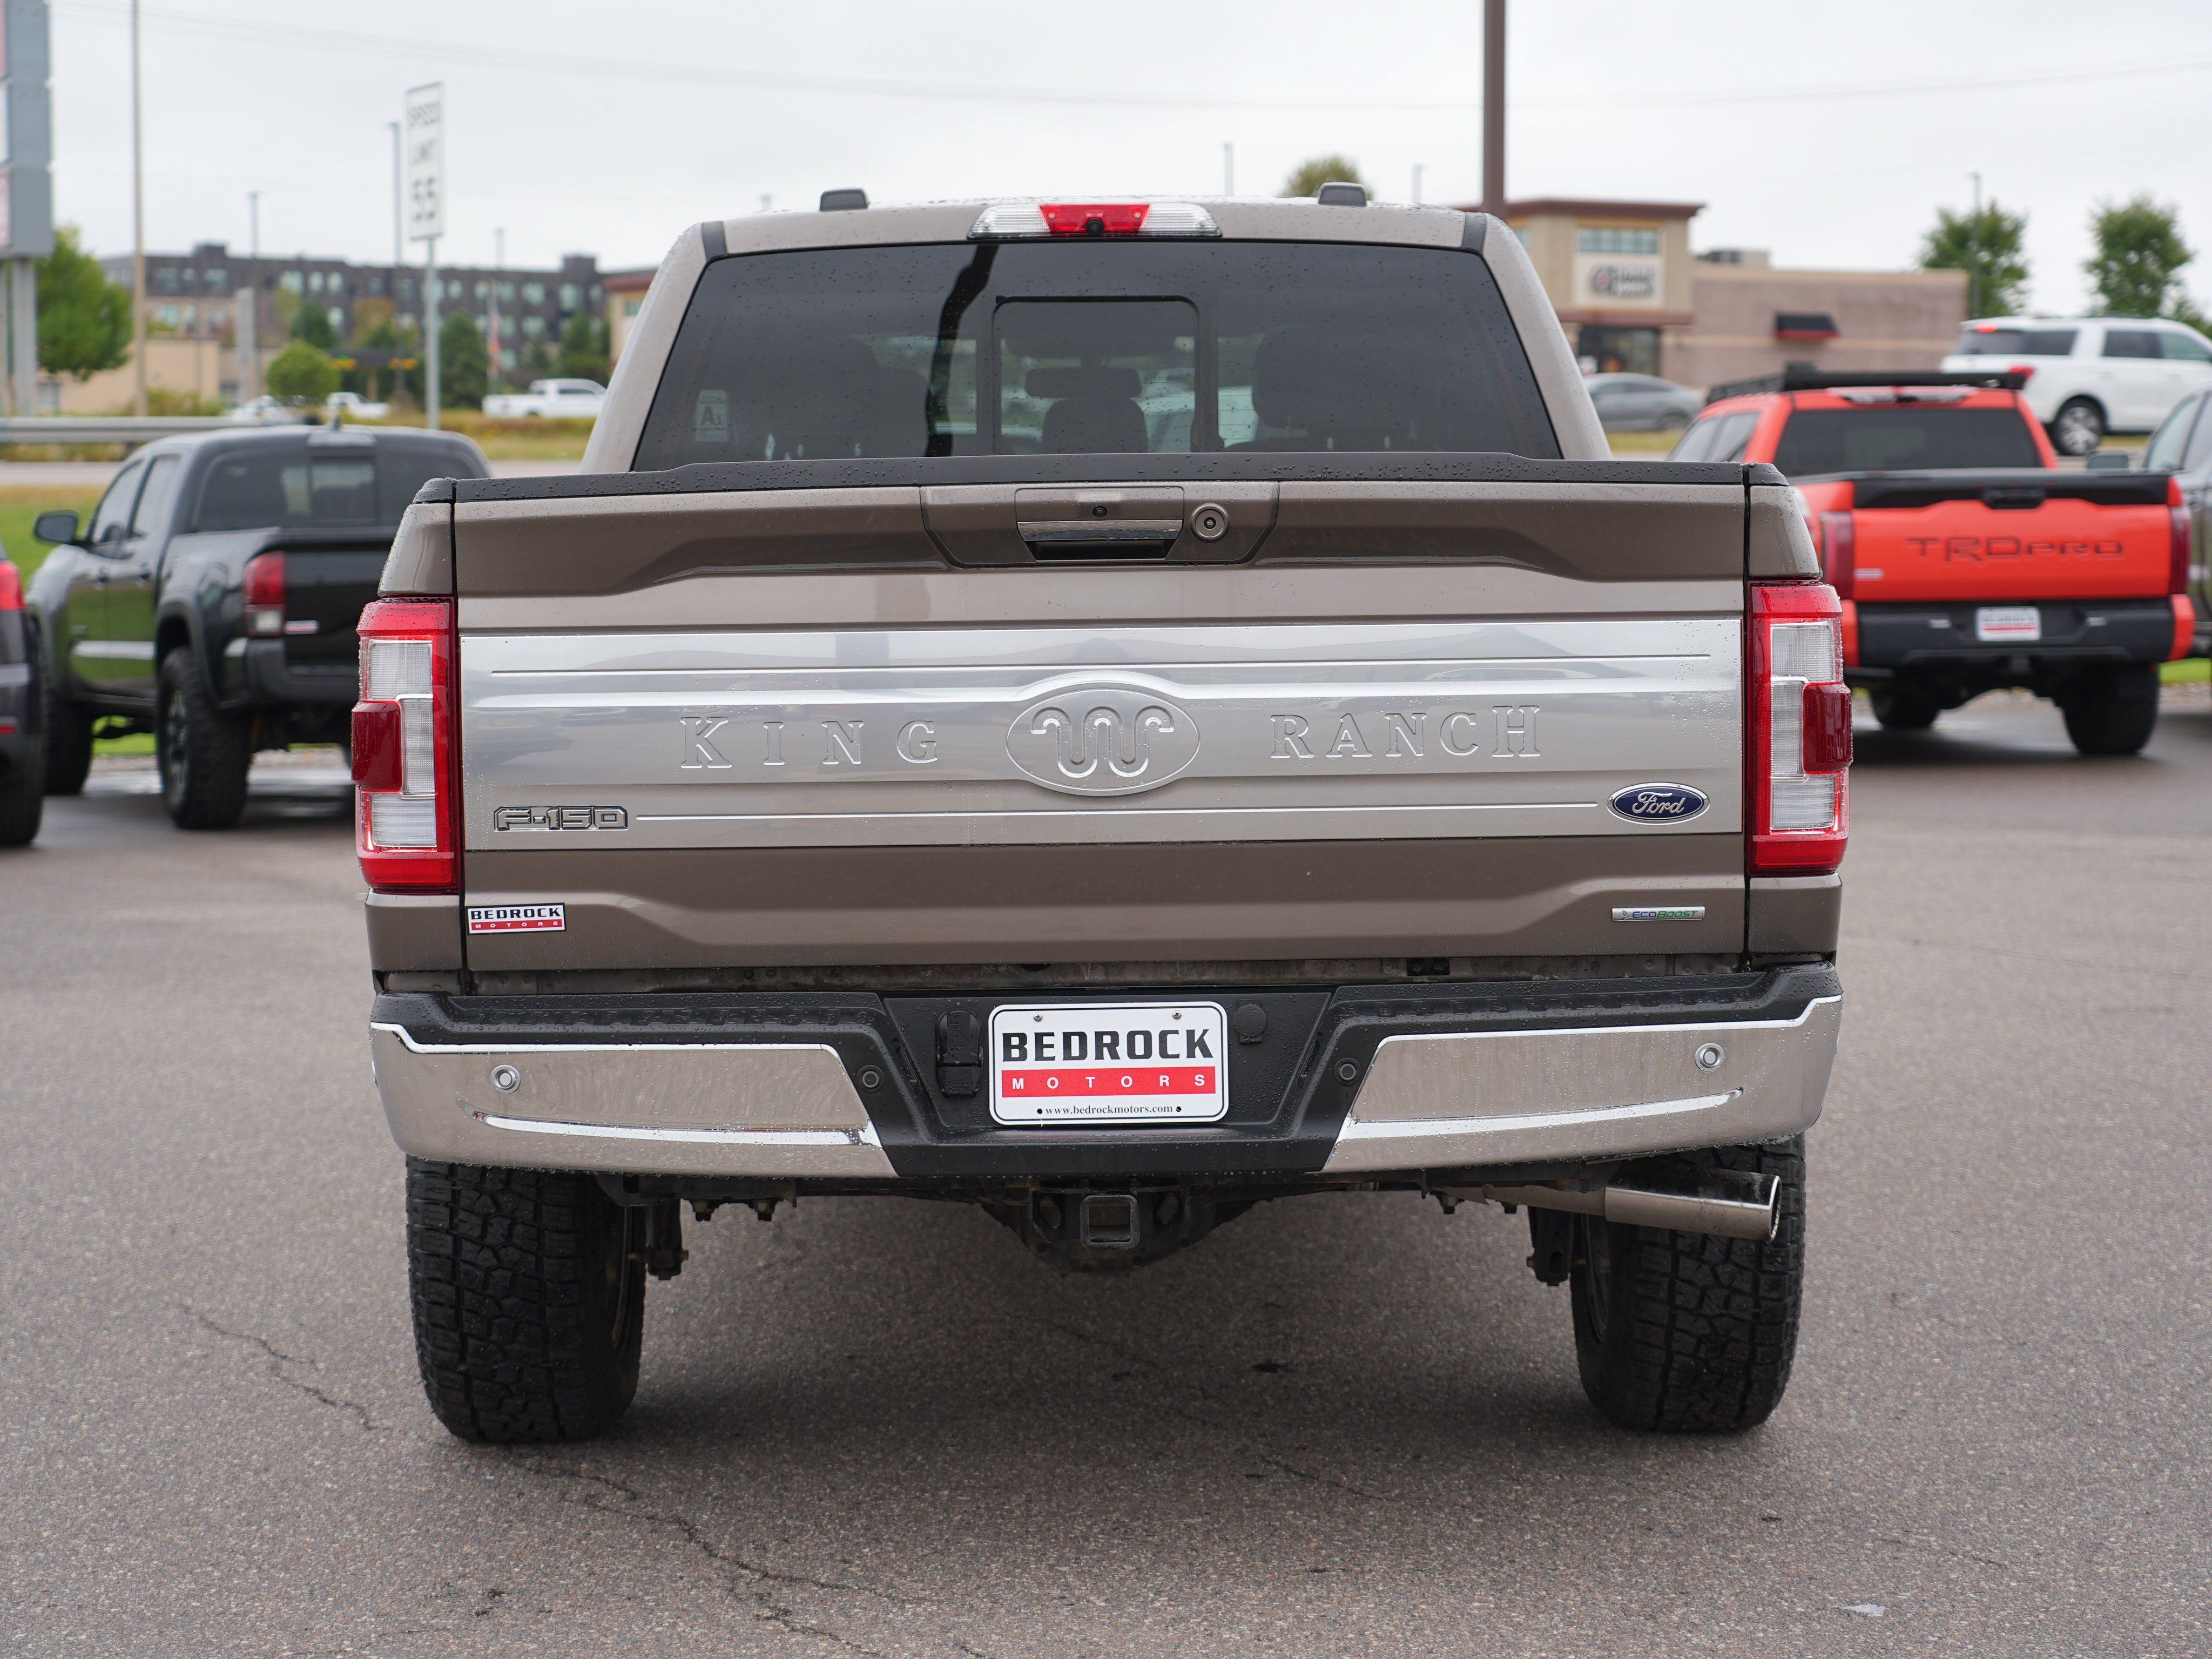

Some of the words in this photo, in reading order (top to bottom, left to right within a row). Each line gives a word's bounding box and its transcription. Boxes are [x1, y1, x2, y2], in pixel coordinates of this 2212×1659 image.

[1906, 537, 2022, 562] TRD
[2026, 541, 2123, 556] PRO
[680, 716, 938, 768] KING
[1270, 705, 1541, 759] RANCH
[1631, 791, 1687, 814] Ford
[494, 805, 629, 832] F-150
[470, 907, 561, 920] BEDROCK
[1632, 910, 1699, 919] ECOBOOST
[475, 920, 558, 929] MOTORS
[1001, 1028, 1215, 1062] BEDROCK
[1011, 1074, 1205, 1090] MOTORS
[1045, 1104, 1173, 1115] www.bedrockmotors.com
